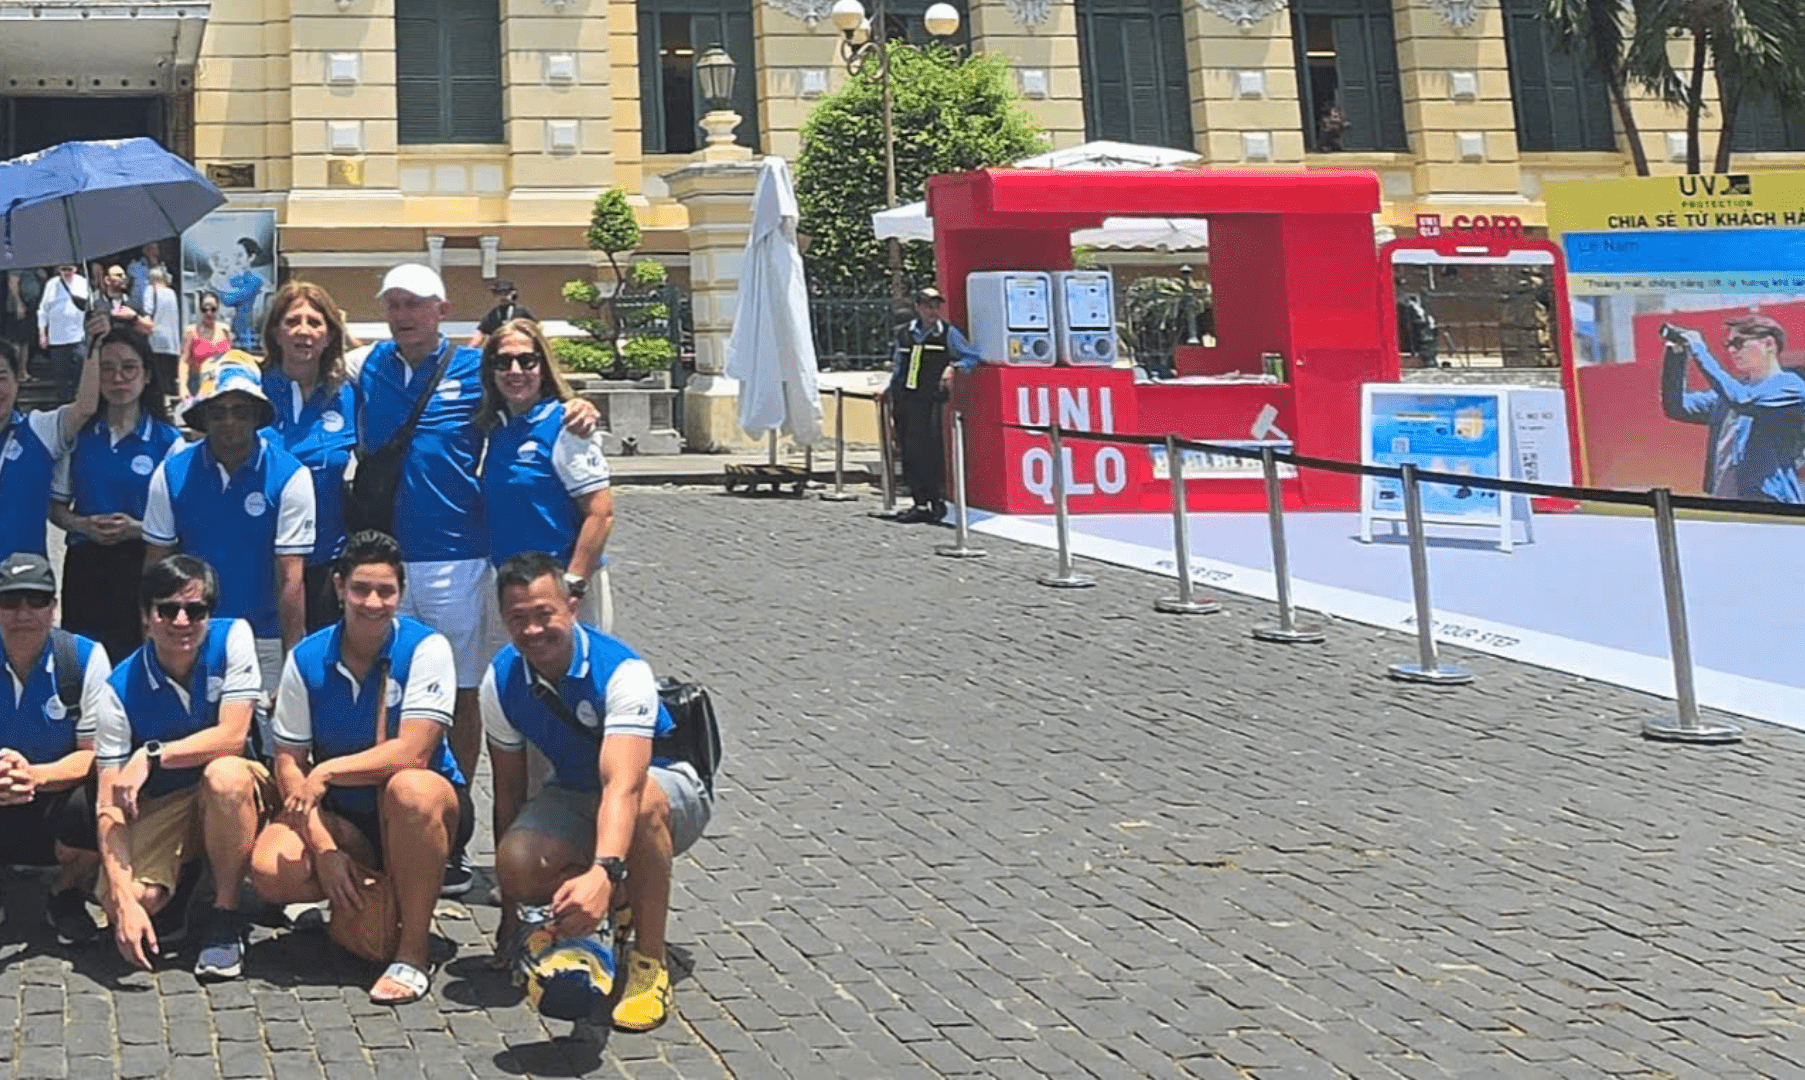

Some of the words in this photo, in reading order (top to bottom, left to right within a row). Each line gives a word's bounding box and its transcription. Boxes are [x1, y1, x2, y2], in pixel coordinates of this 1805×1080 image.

[1679, 174, 1716, 196] UV
[1607, 214, 1649, 229] CHIA
[1017, 386, 1114, 435] UNI
[1022, 445, 1127, 505] QLO
